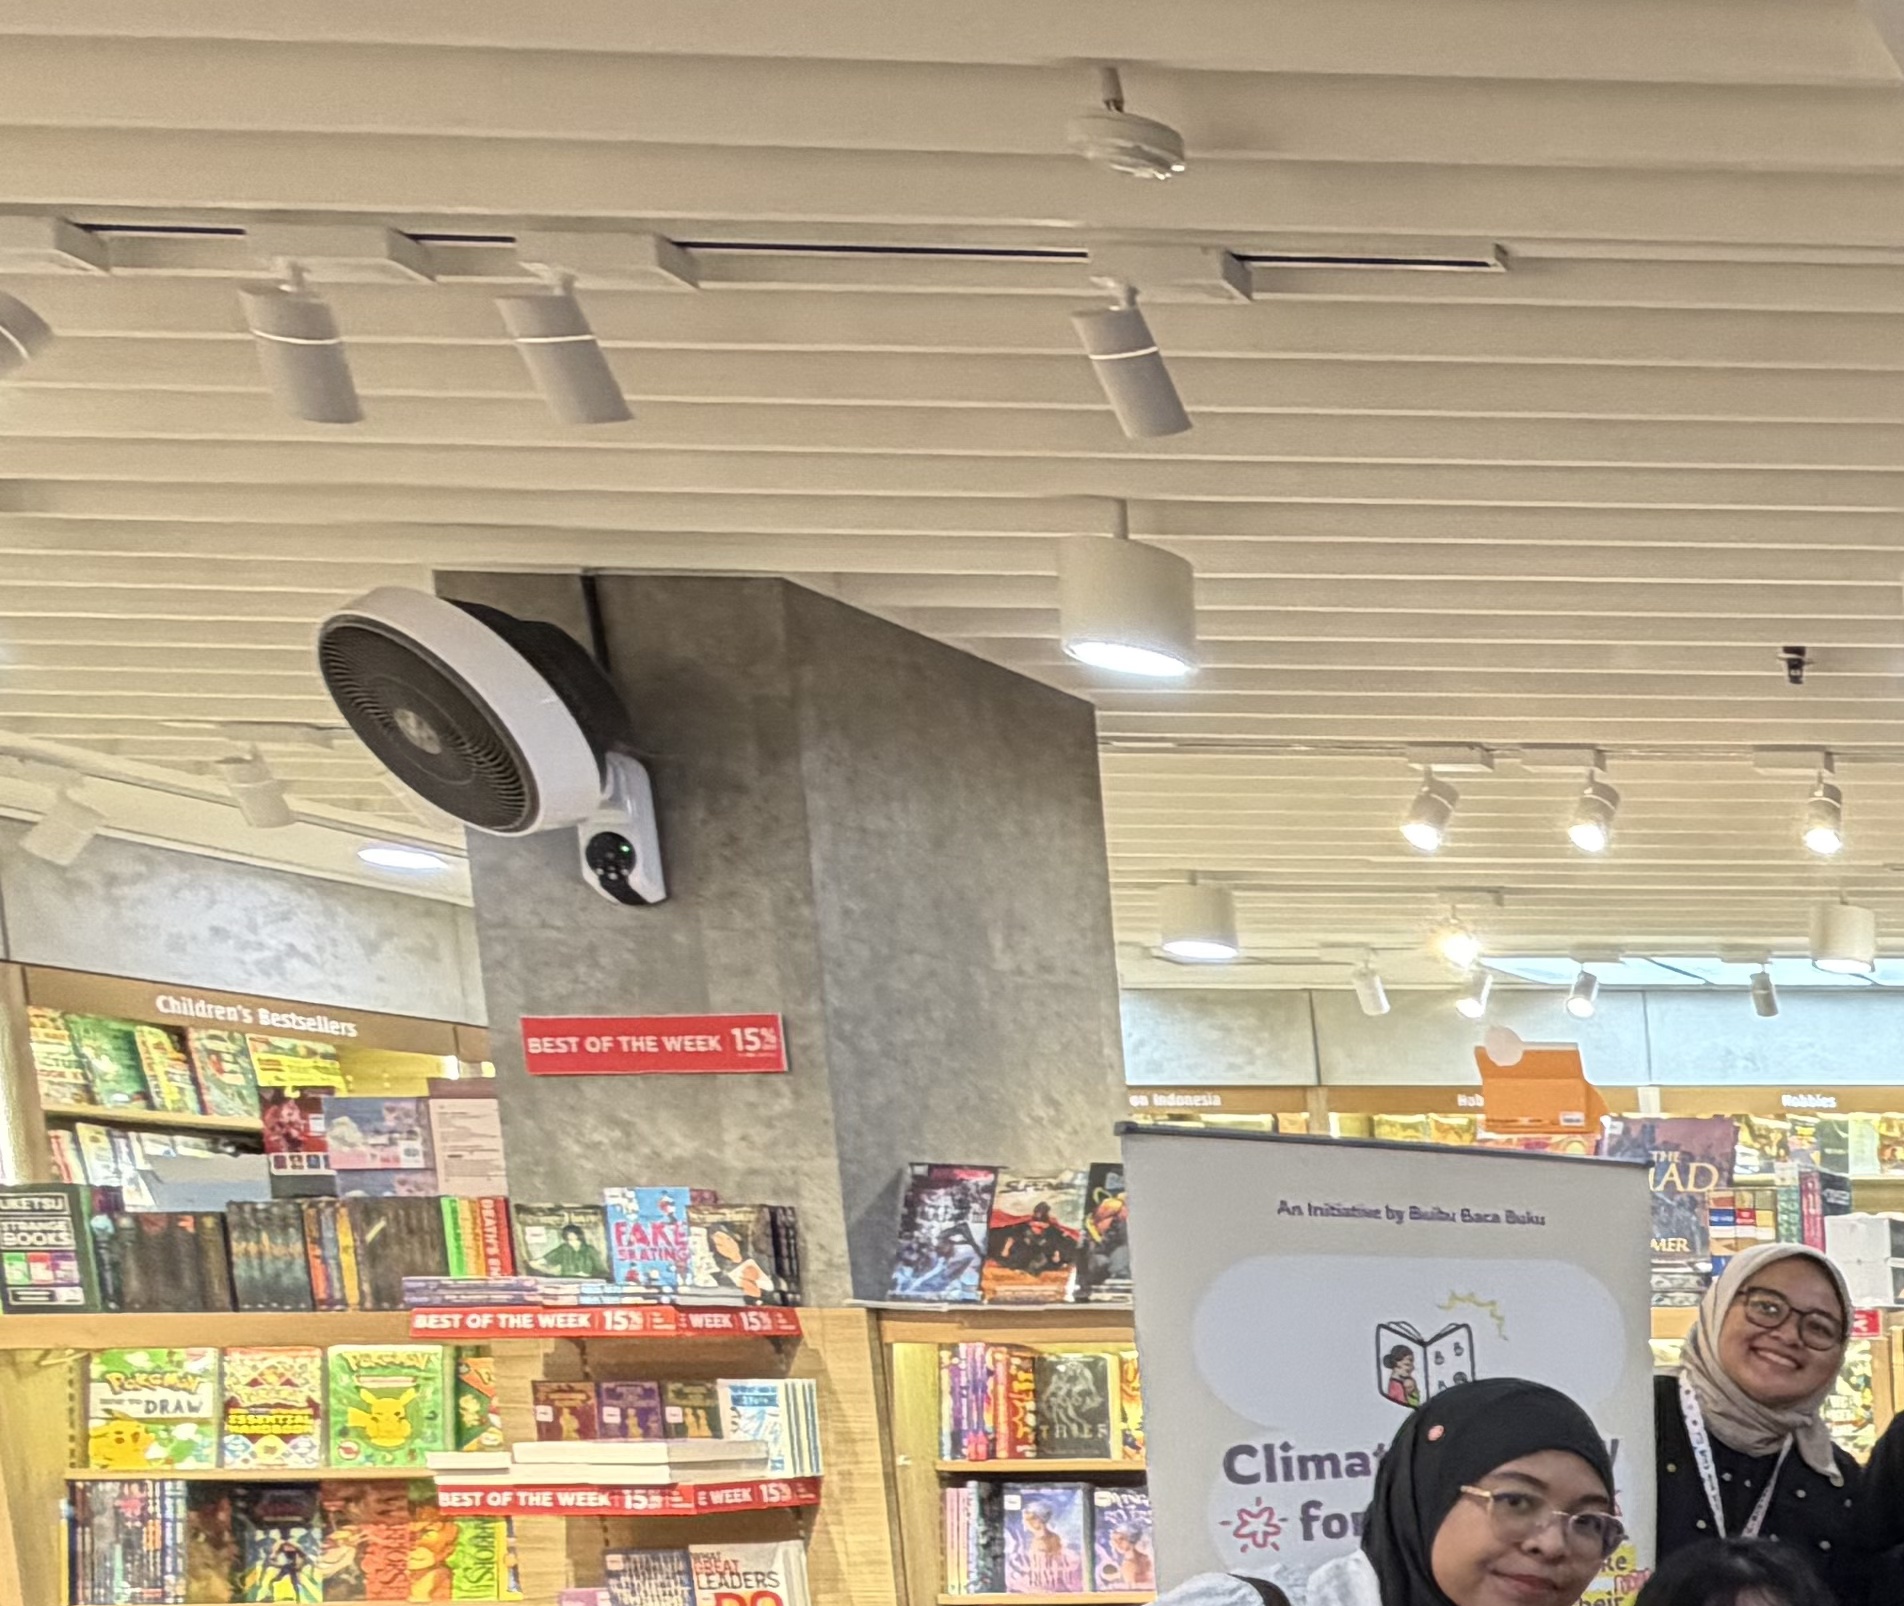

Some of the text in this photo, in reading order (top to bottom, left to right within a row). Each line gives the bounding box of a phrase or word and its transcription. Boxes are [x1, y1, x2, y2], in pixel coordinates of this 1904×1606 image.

[155, 994, 358, 1038] Children's Bestsellers
[528, 1036, 580, 1054] BEST
[585, 1036, 615, 1053] OF
[619, 1035, 658, 1053] THE
[662, 1035, 722, 1052] WEEK
[1153, 1093, 1222, 1107] Indonesia
[1781, 1093, 1837, 1109] Hobbies
[1277, 1201, 1546, 1226] An Initiative by Buibu Baca Buku
[613, 1219, 688, 1252] FAKE
[617, 1248, 691, 1263] SKATING
[414, 1313, 463, 1330] BEST
[466, 1313, 495, 1329] OF
[498, 1312, 534, 1329] THE
[537, 1312, 591, 1328] WEEK
[690, 1314, 734, 1329] WEEK
[144, 1398, 204, 1415] DRAW
[438, 1490, 487, 1508] BEST
[490, 1490, 519, 1507] OF
[521, 1490, 557, 1507] THE
[560, 1490, 612, 1507] WEEK
[710, 1489, 753, 1506] WEEK
[695, 1559, 740, 1576] GREAT
[698, 1571, 780, 1590] LEADERS
